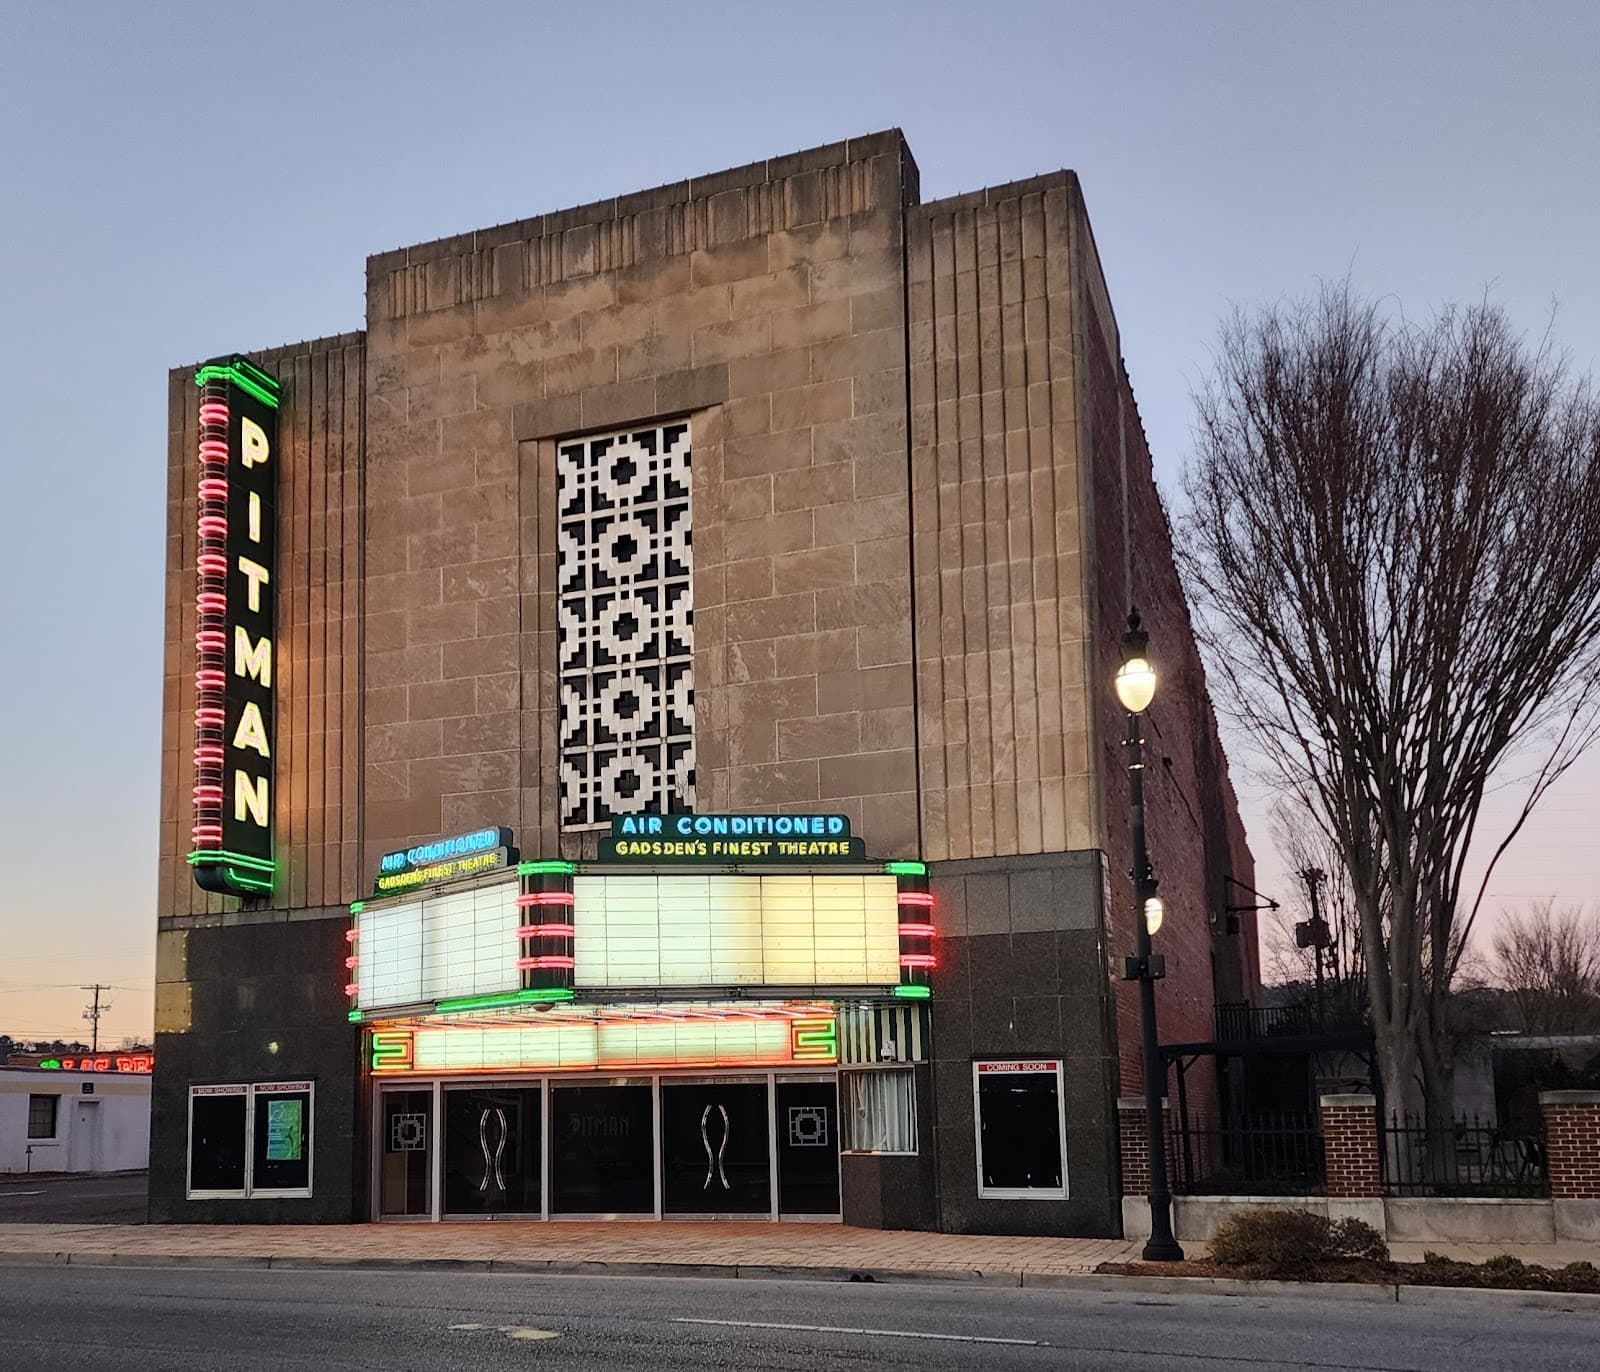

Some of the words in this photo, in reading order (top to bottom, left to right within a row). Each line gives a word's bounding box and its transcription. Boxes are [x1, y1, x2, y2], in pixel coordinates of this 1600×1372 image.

[232, 416, 272, 828] PITMAN
[621, 816, 663, 835] AIR
[677, 816, 844, 835] CONDITIONED
[381, 852, 406, 871] AIR
[407, 830, 496, 865] CONDITIONED
[615, 838, 707, 856] GADSDEN'S
[712, 841, 773, 856] FINEST
[777, 841, 850, 856] THEATRE
[378, 867, 424, 890] GADSDEN'S
[424, 862, 455, 881] FINEST
[458, 852, 498, 873] THEATRE
[986, 1064, 1020, 1072] COMING
[1022, 1063, 1047, 1071] SOON
[568, 1112, 629, 1137] PITMAN
